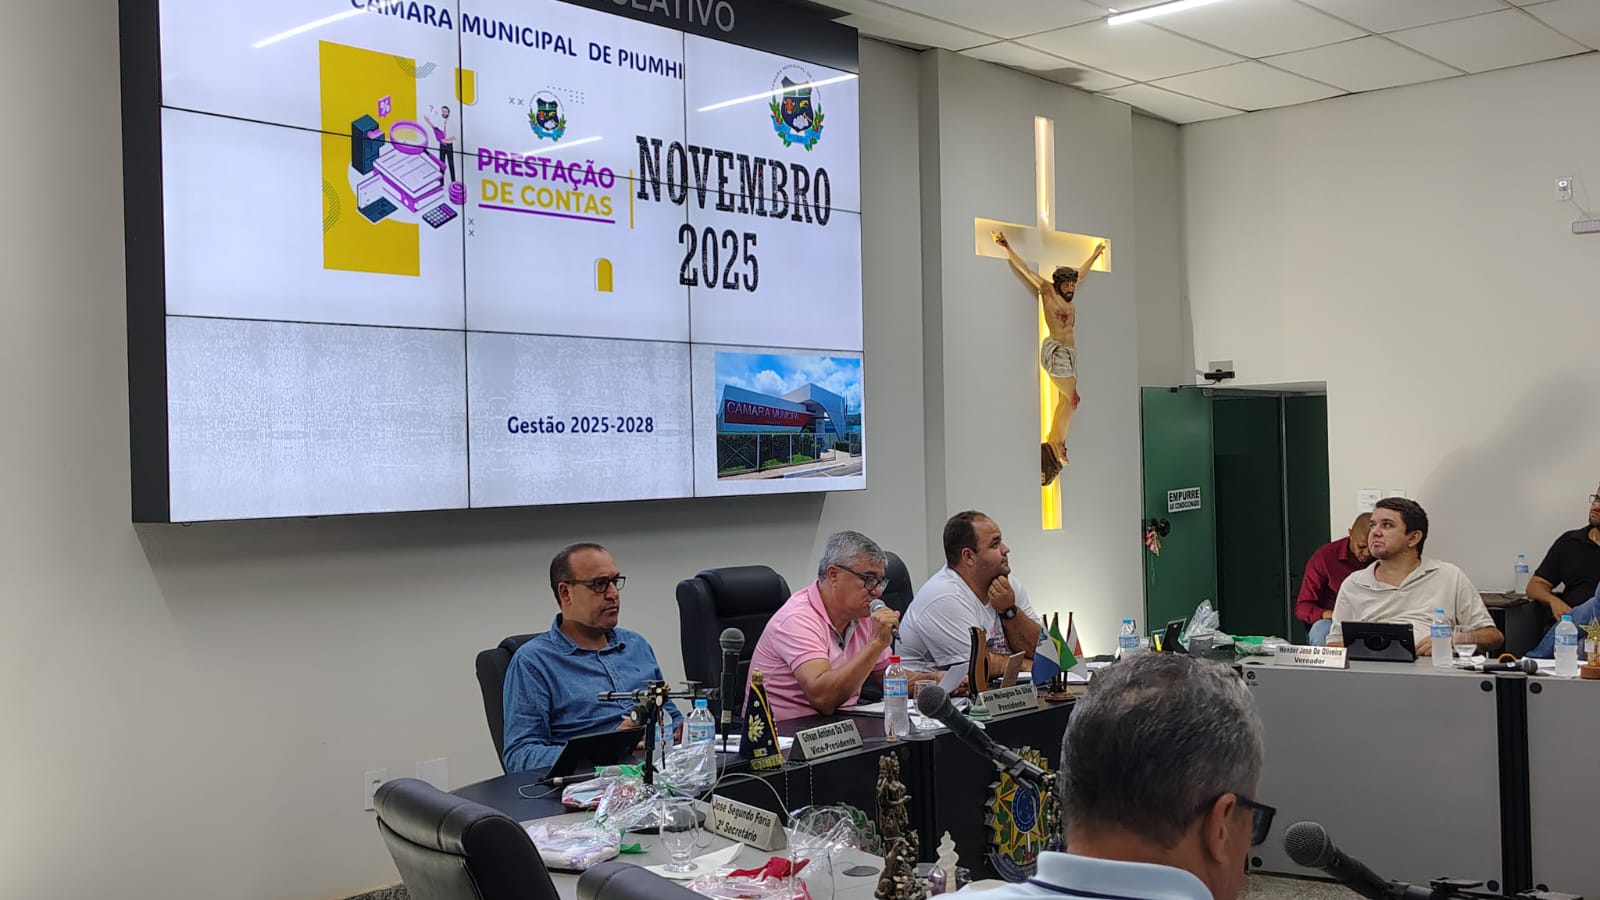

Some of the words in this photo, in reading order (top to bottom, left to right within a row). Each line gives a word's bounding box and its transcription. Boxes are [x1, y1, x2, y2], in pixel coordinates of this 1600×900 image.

[462, 13, 577, 57] MUNICIPAL
[589, 42, 612, 64] DE
[618, 49, 683, 80] PIUMHI
[477, 147, 615, 191] PRESTAÇÃO
[636, 135, 831, 226] NOVEMBRO
[481, 179, 514, 203] DE
[520, 185, 613, 216] CONTAS
[678, 223, 759, 292] 2025
[507, 415, 566, 434] Gestão
[570, 416, 654, 433] 2025-2028
[1169, 489, 1199, 502] EMPURRE
[1295, 656, 1326, 665] Vereador
[998, 700, 1026, 711] Presidente
[841, 722, 854, 733] Silva
[810, 737, 857, 755] Vice-Presidente
[727, 803, 754, 820] Segundo
[754, 811, 772, 828] Faria
